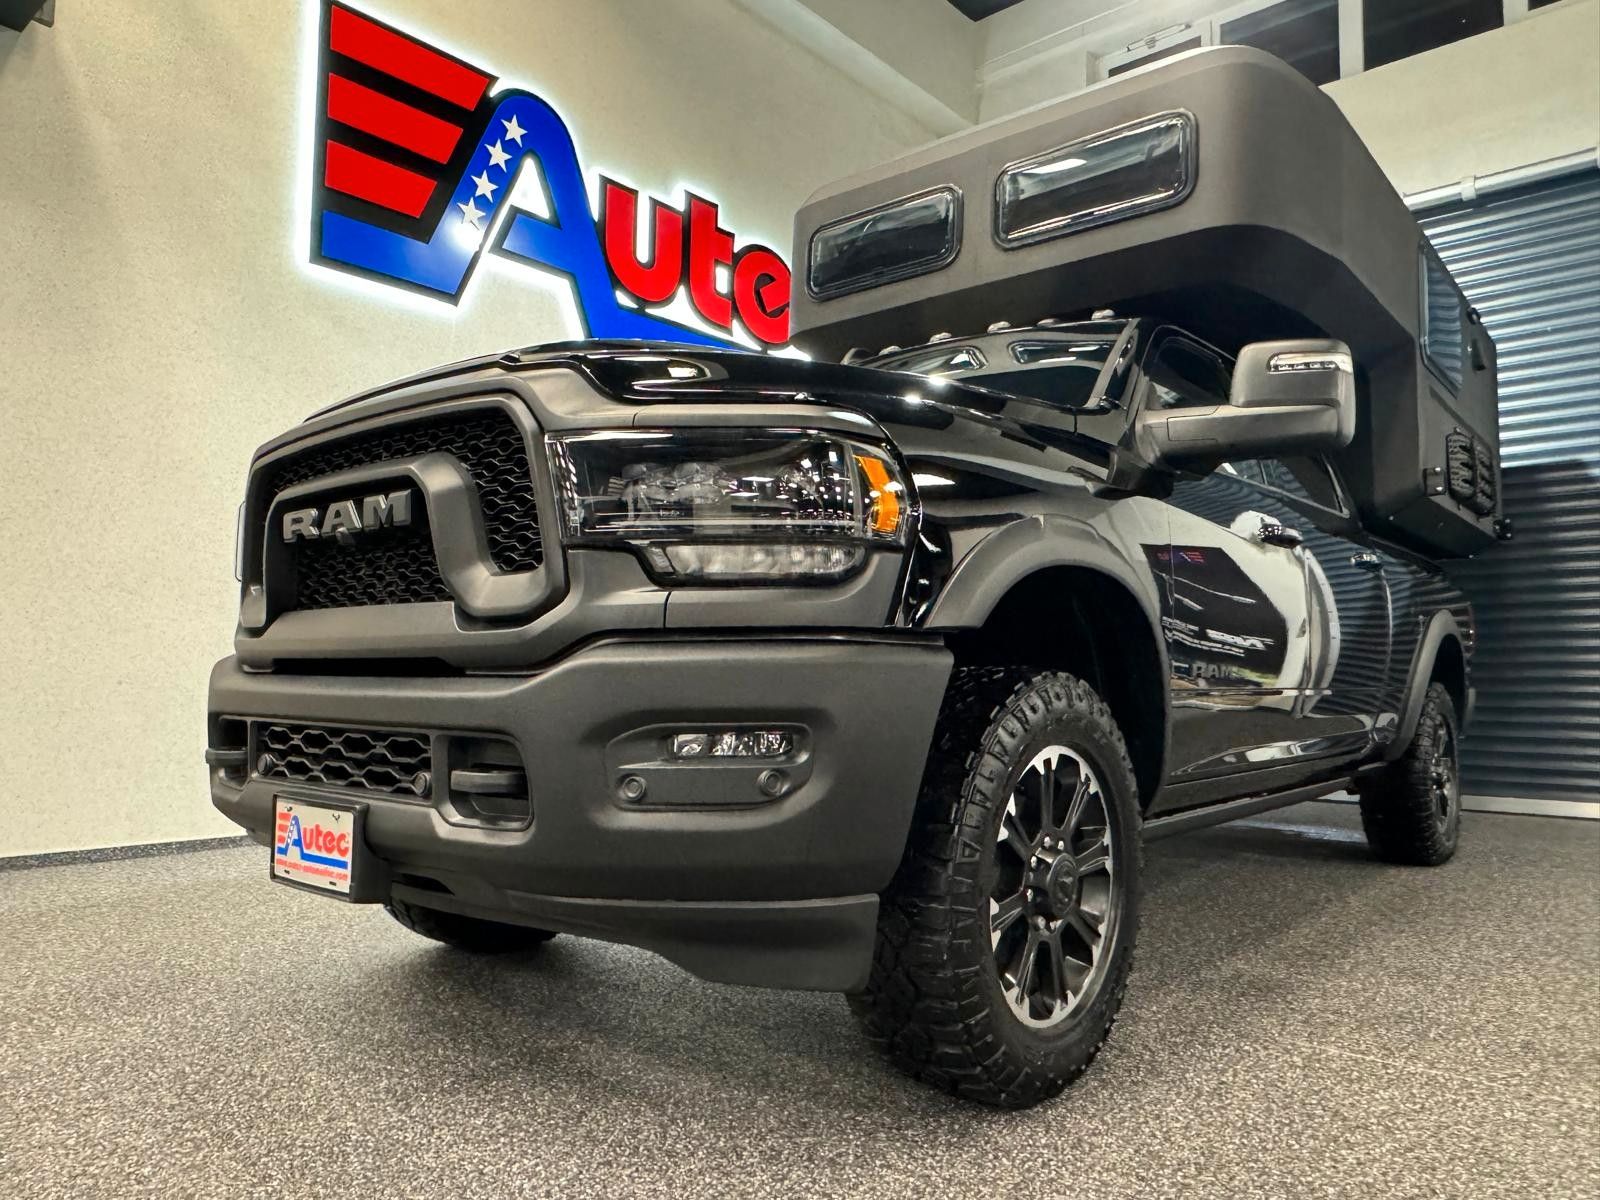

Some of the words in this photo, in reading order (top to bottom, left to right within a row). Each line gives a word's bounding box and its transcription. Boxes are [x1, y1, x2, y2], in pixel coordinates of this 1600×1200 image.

[432, 88, 790, 350] Aute
[283, 489, 412, 543] RAM
[284, 815, 349, 857] Autec
